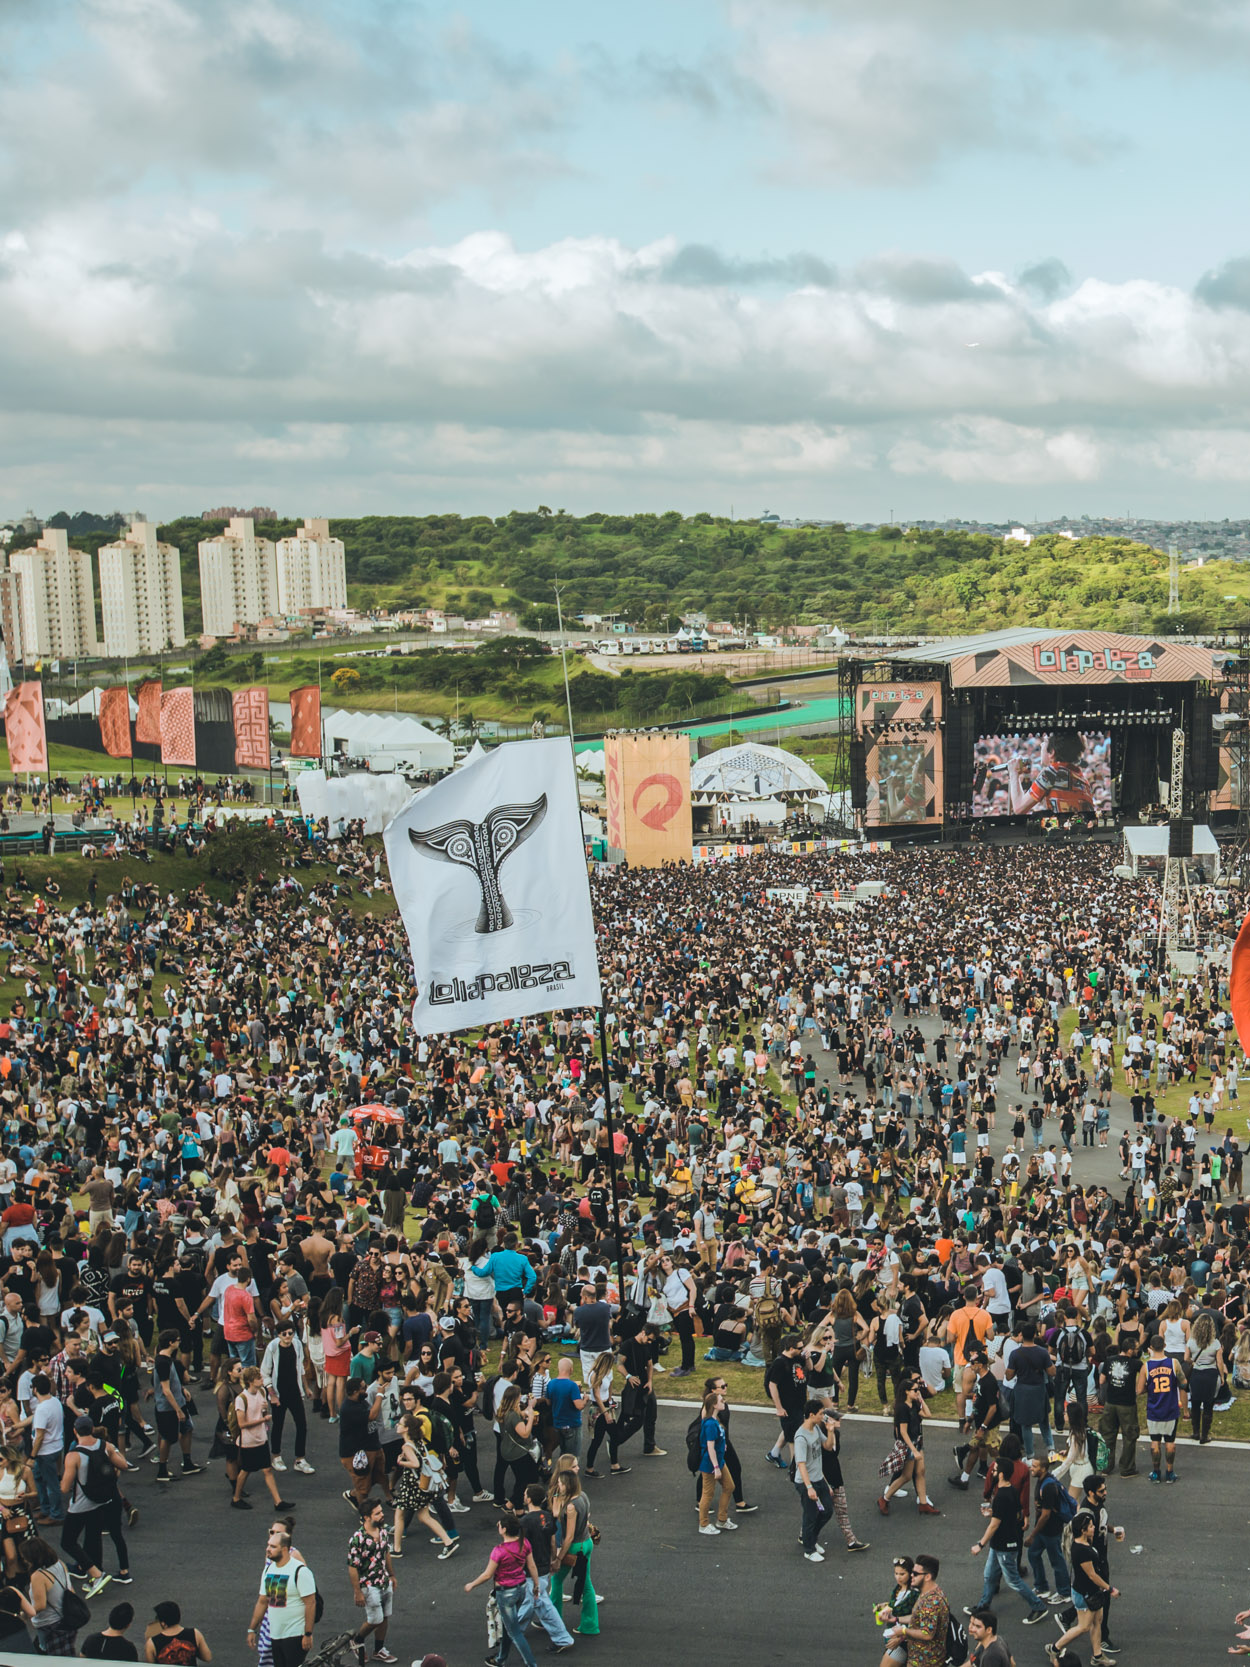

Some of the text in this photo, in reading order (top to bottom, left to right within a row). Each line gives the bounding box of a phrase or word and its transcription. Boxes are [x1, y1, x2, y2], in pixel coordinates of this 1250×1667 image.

[1032, 645, 1157, 674] Lollapalooza
[429, 961, 576, 1006] Lollapalooza
[546, 983, 565, 993] BRASIL
[1152, 1376, 1171, 1393] 12
